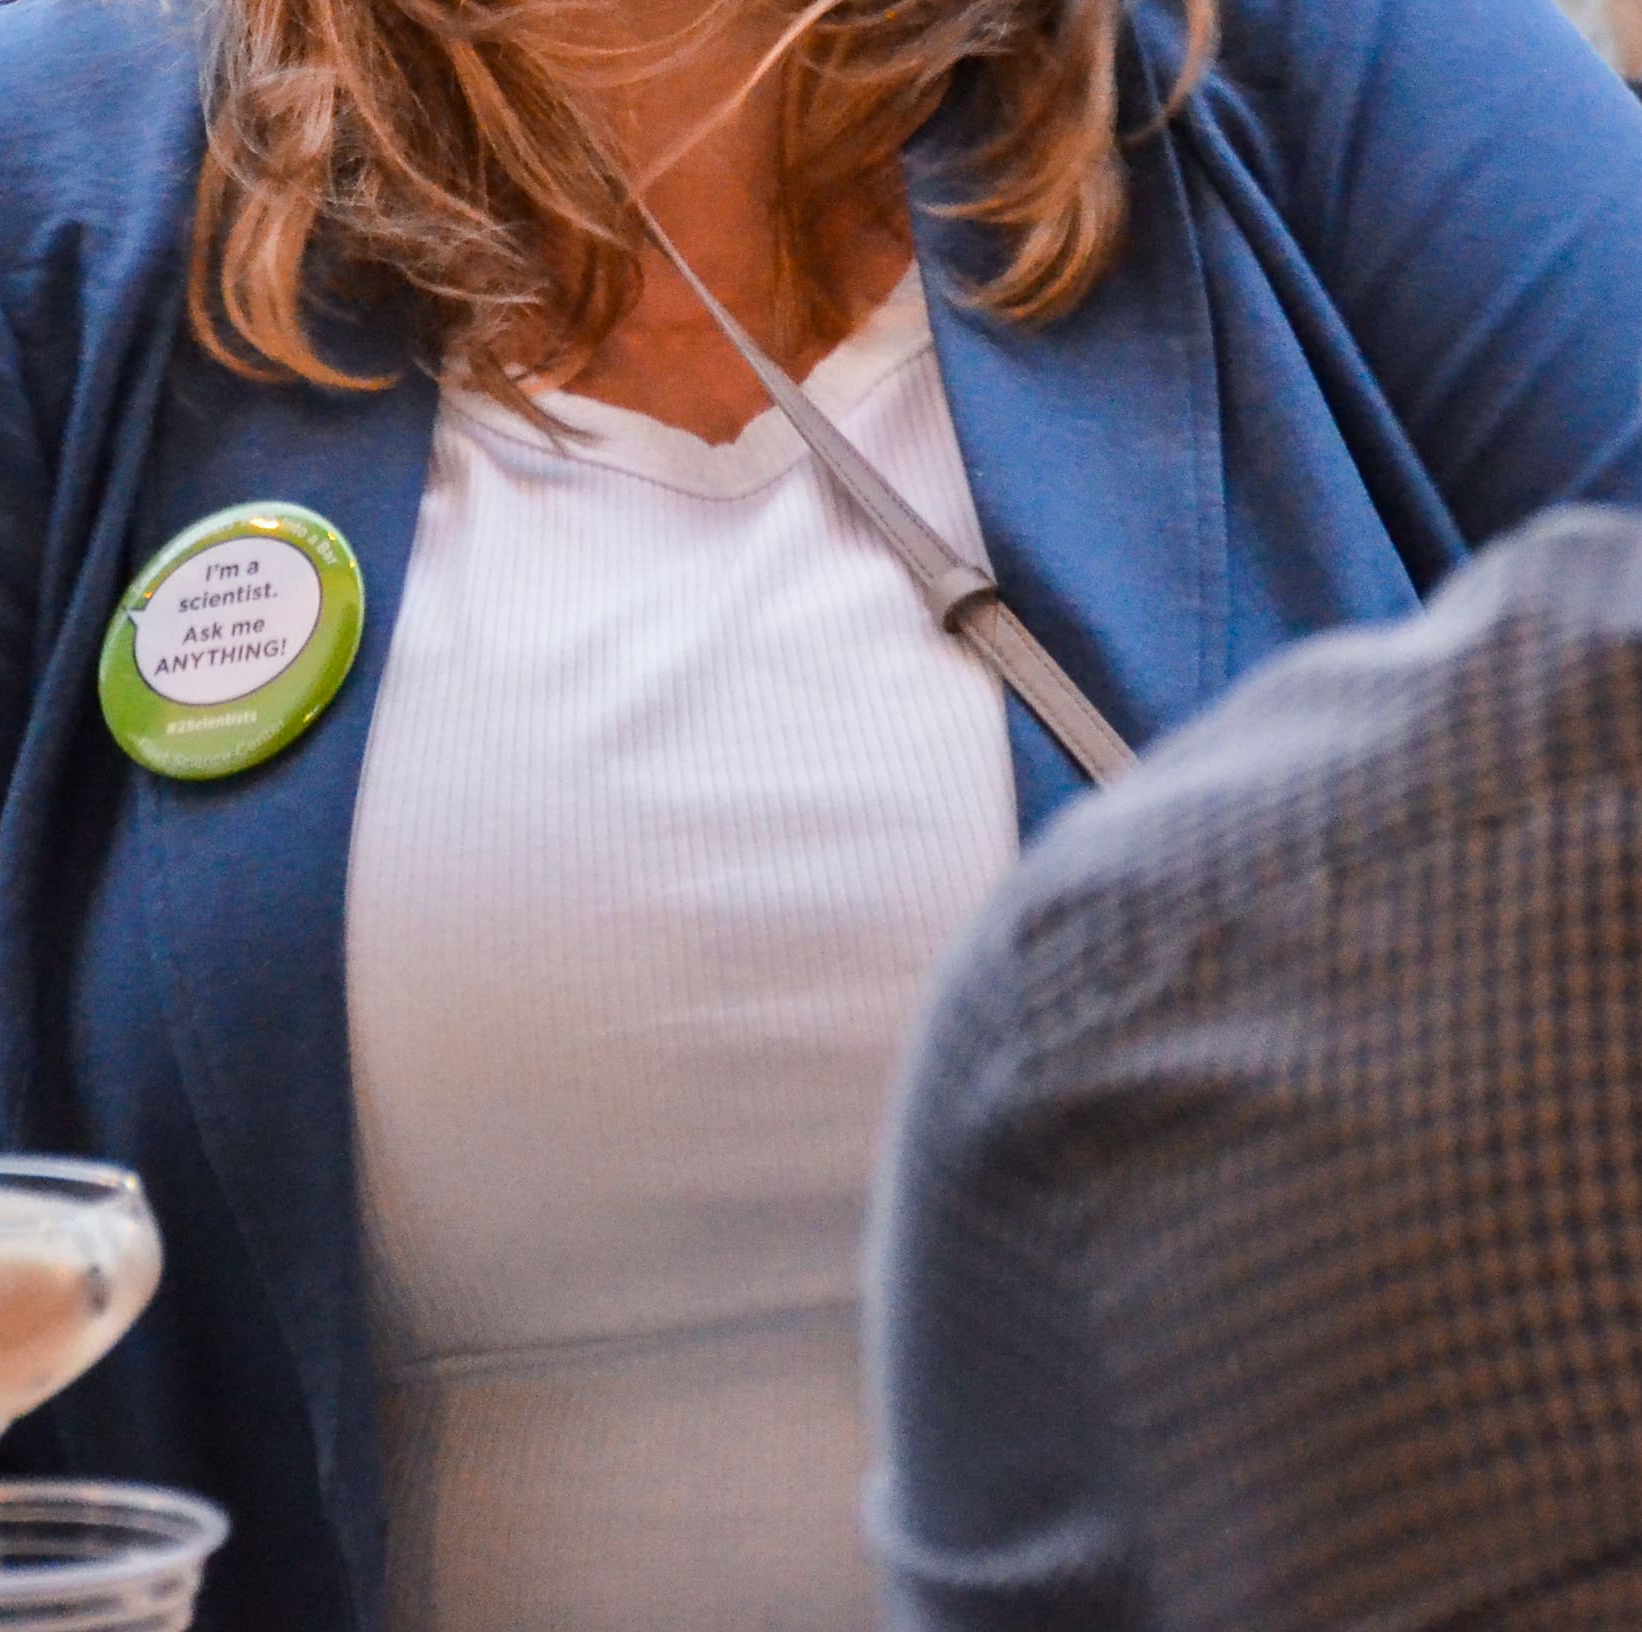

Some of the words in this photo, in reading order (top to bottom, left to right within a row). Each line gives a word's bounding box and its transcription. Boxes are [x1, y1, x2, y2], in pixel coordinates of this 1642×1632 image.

[206, 563, 239, 582] I'm
[247, 560, 260, 575] a
[178, 581, 278, 613] scientist.
[182, 622, 224, 646] Ask
[230, 618, 266, 638] me
[154, 637, 287, 676] ANYTHING!
